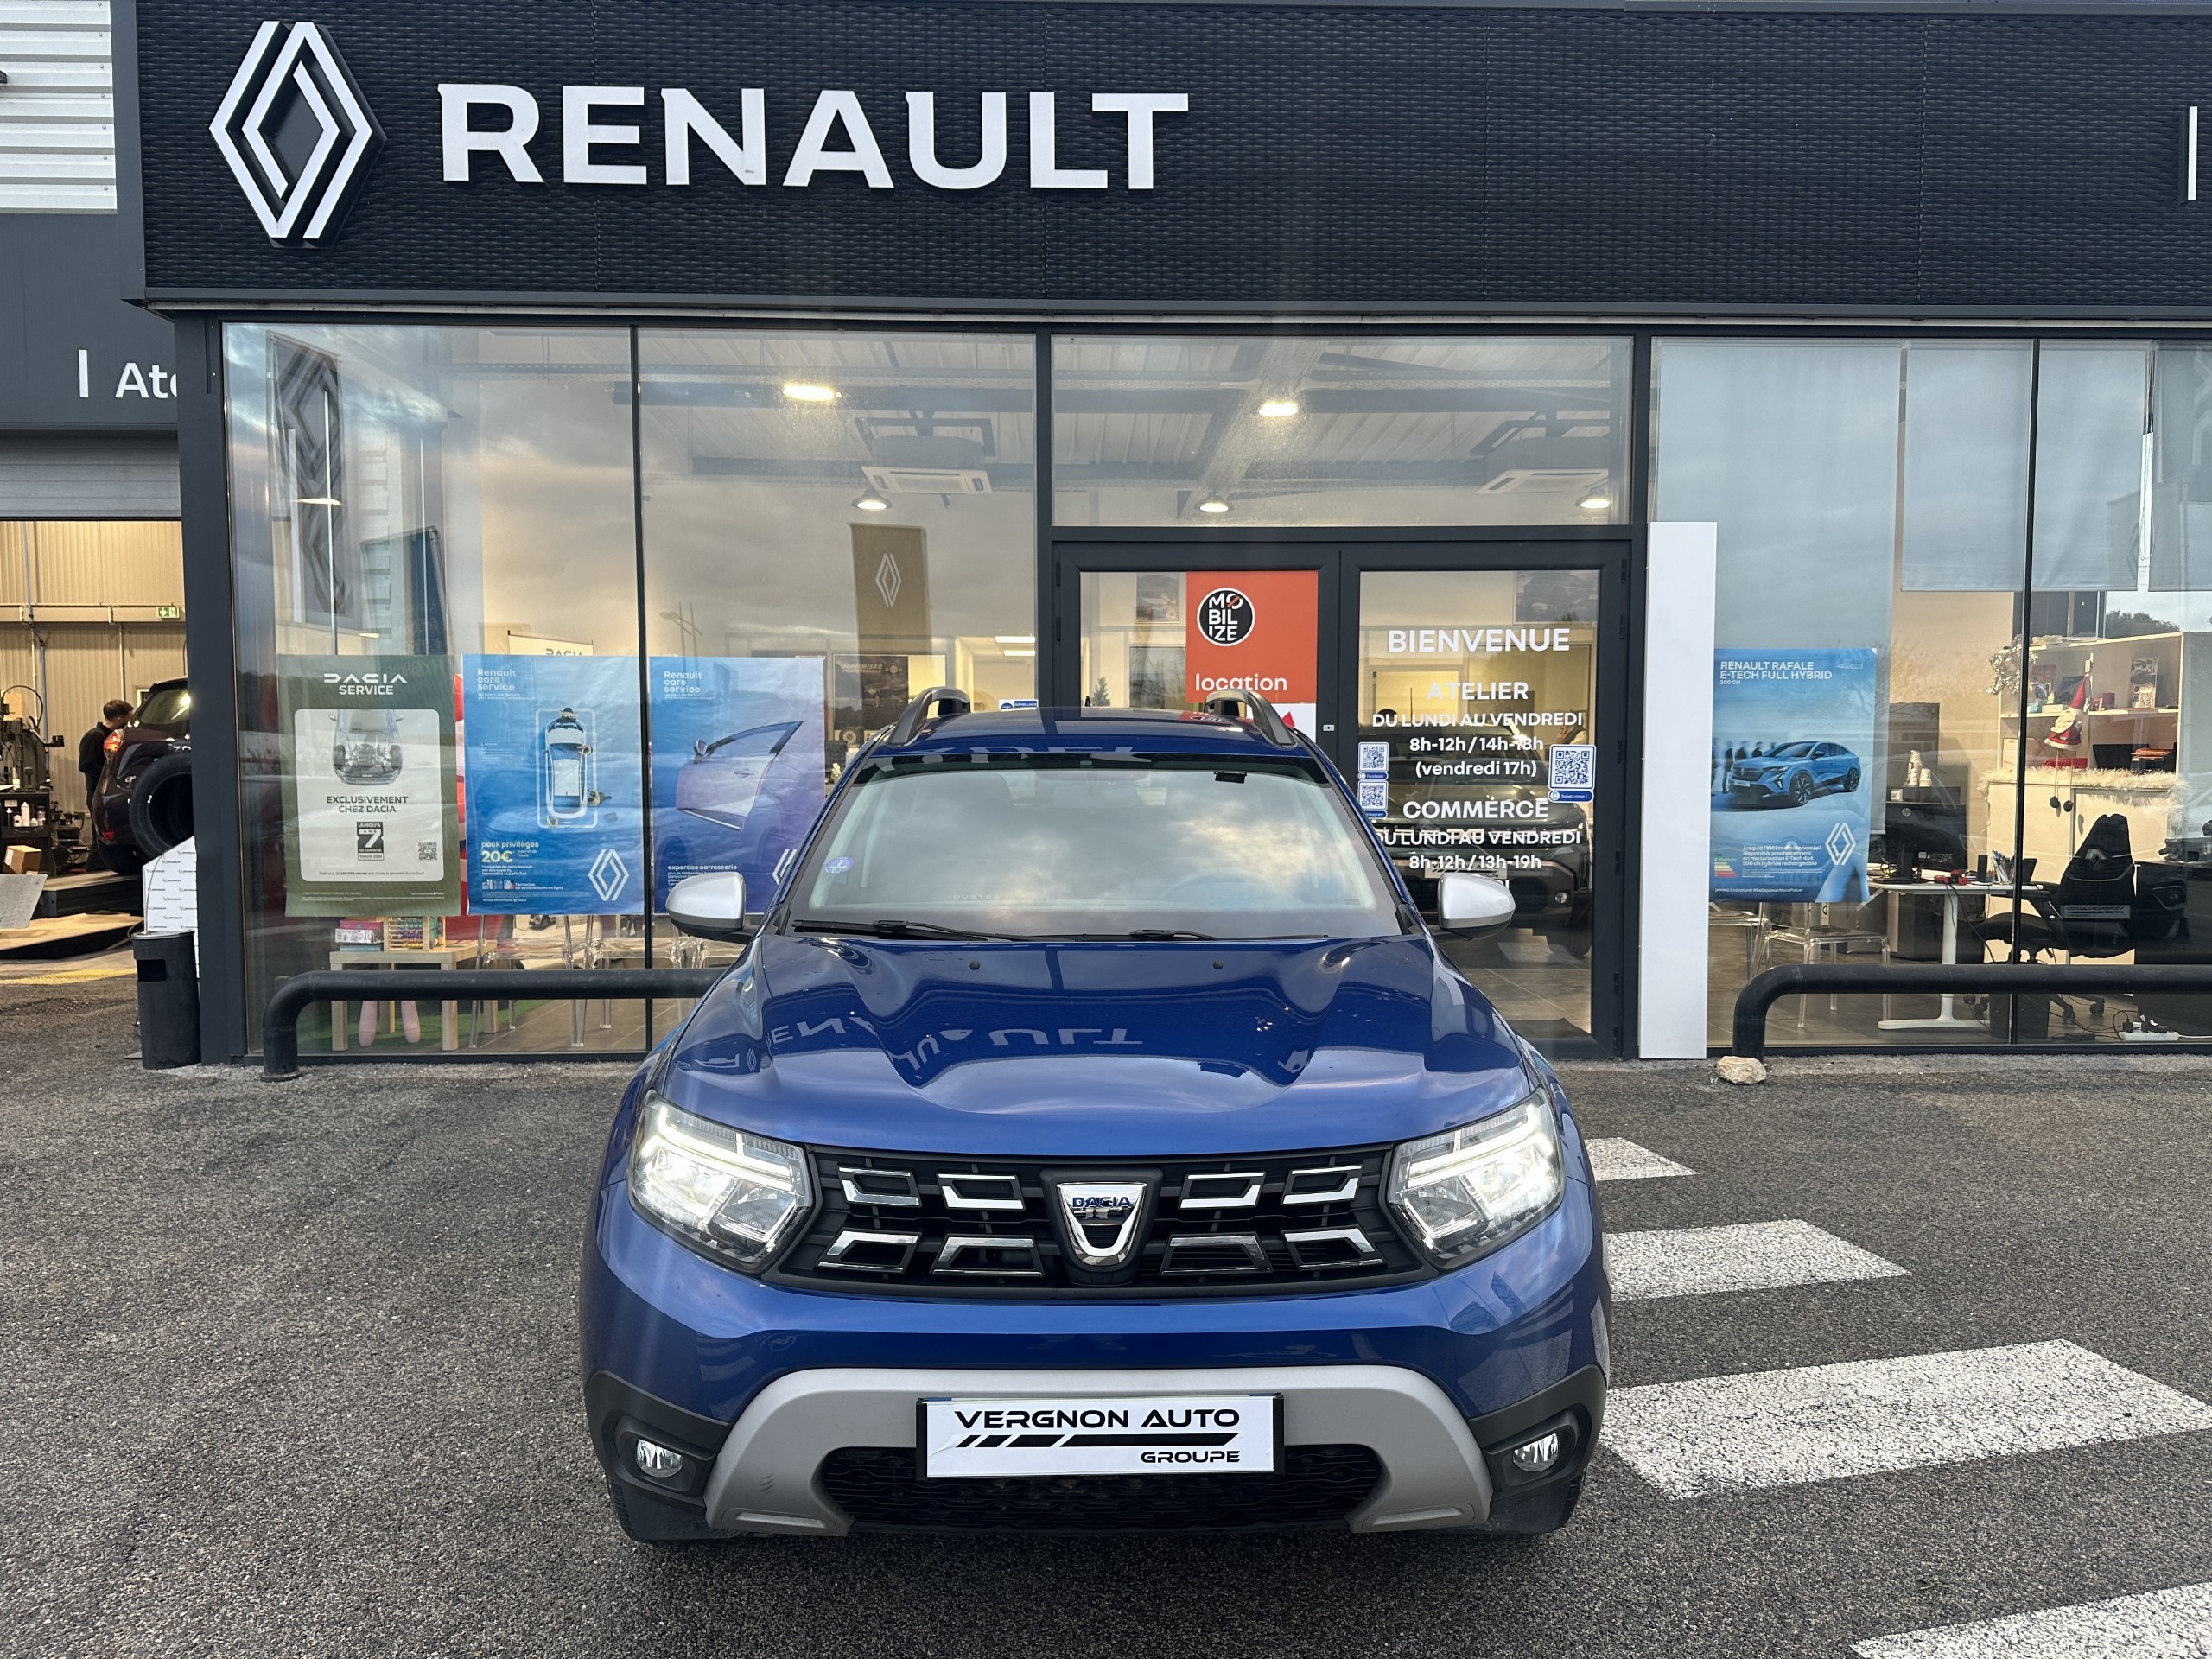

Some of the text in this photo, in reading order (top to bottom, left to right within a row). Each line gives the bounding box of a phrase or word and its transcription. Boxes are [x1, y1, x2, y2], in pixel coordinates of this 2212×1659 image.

[437, 83, 1189, 190] RENAULT
[1388, 628, 1570, 652] BIENVENUE
[477, 668, 517, 677] Renault
[1720, 661, 1814, 670] RENAULT RAFALE
[324, 673, 408, 683] DACIA
[664, 671, 702, 679] Renault
[1195, 673, 1287, 691] location
[1720, 671, 1833, 679] E-TECH FULL HYBRID
[339, 685, 394, 695] SERVICE
[1427, 682, 1529, 700] ATELIER
[1372, 712, 1582, 727] DU LUNDI AU VENDREDI
[1409, 736, 1543, 753] 8h-12h / 14h-18h
[1415, 761, 1537, 778] (vendredi 17h)
[1402, 800, 1549, 819] COMMERCE
[359, 829, 382, 848] 7
[1401, 831, 1455, 845] LUNDI
[1459, 831, 1484, 845] AU
[1488, 831, 1580, 845] VENDREDI
[1409, 855, 1541, 872] 8h-12h / 13h-19h
[1072, 1196, 1132, 1208] DACIA
[954, 1409, 1240, 1429] VERGNON AUTO
[1141, 1451, 1241, 1464] GROUPE
